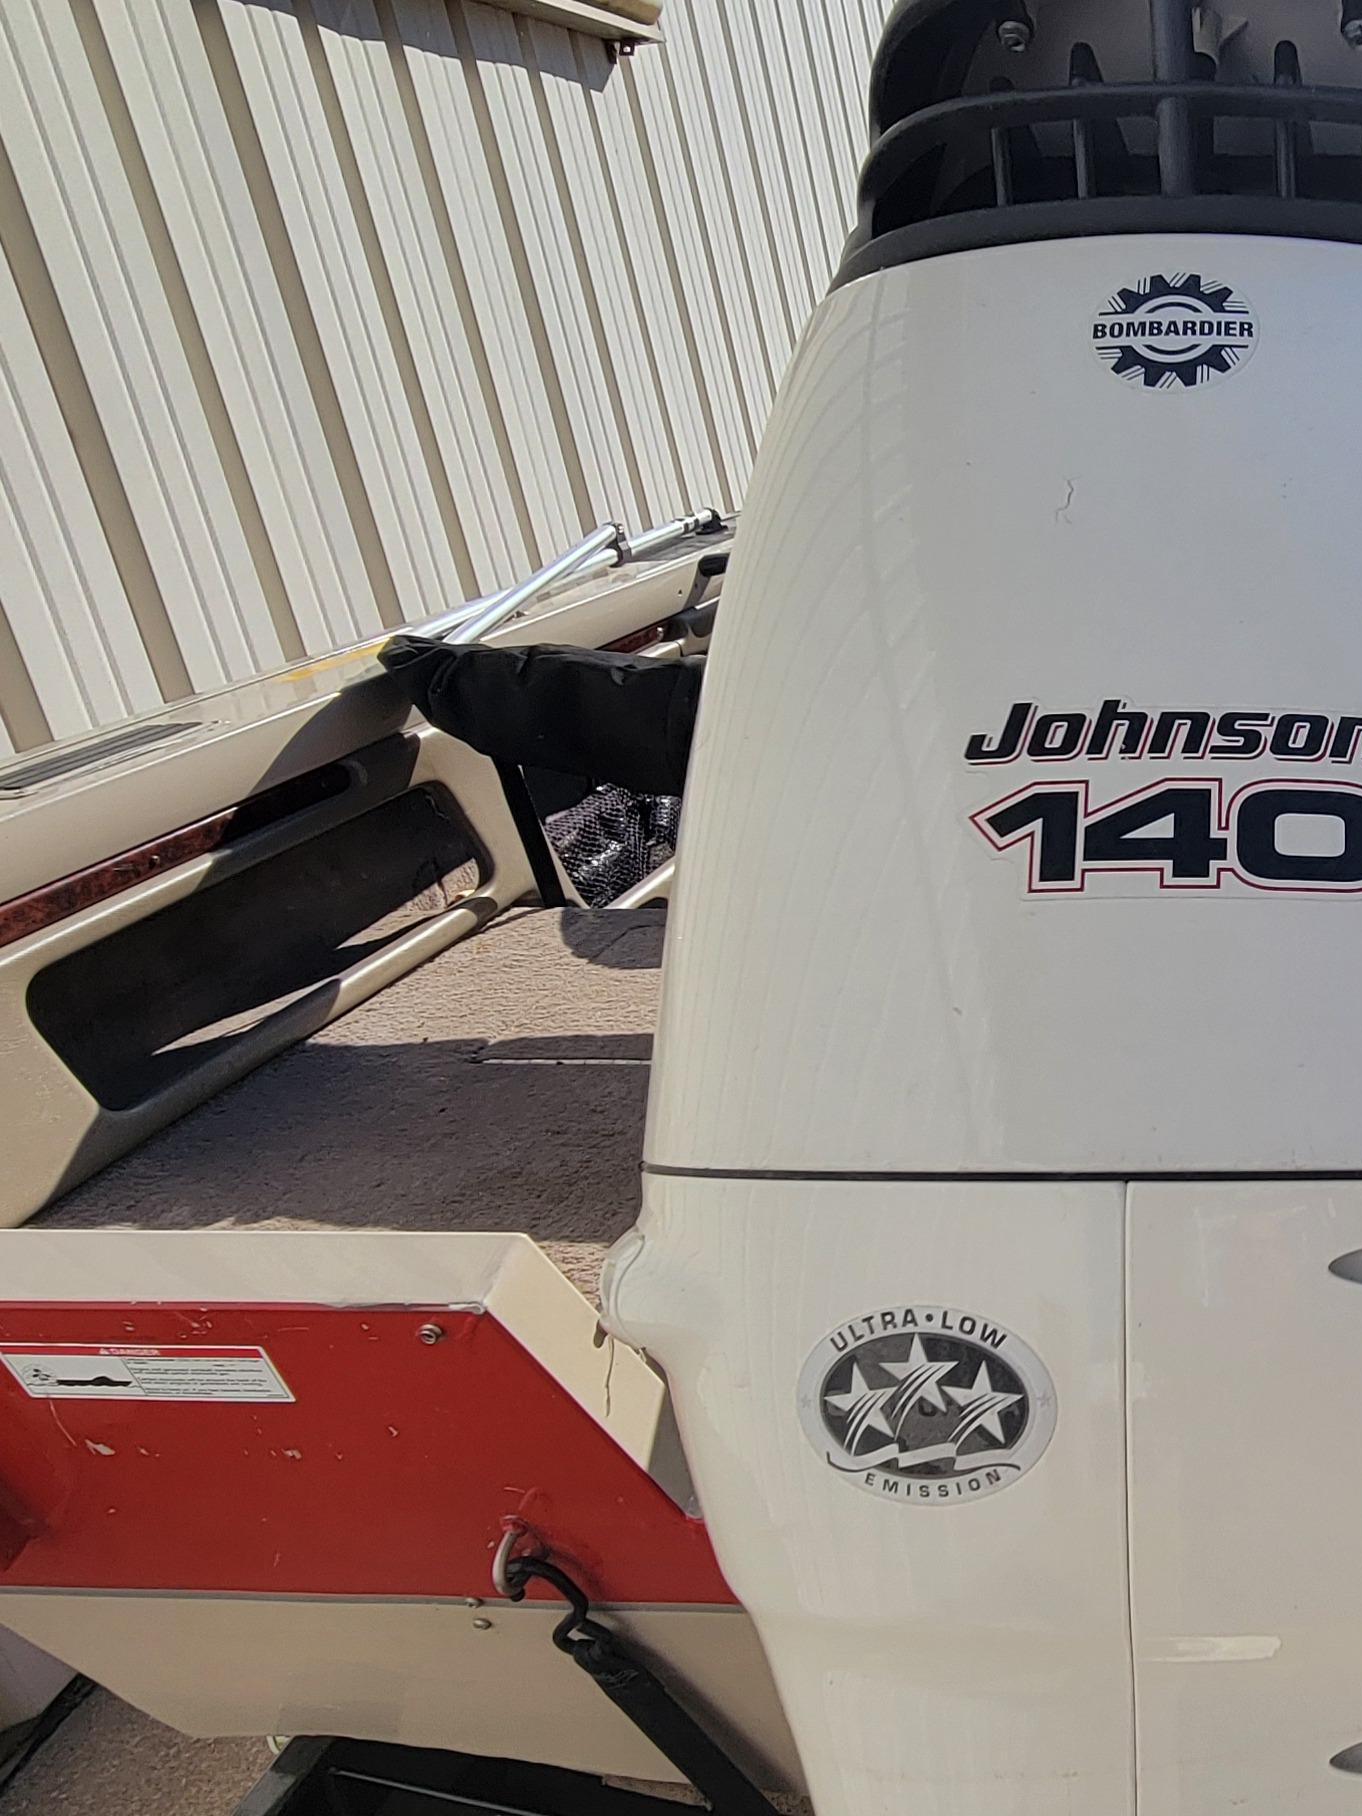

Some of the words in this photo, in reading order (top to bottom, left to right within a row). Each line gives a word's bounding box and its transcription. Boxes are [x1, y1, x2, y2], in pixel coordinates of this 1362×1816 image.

[1092, 320, 1254, 340] BOMBARDIER
[109, 1347, 160, 1357] DANGER
[863, 1467, 1003, 1498] EMISSION
